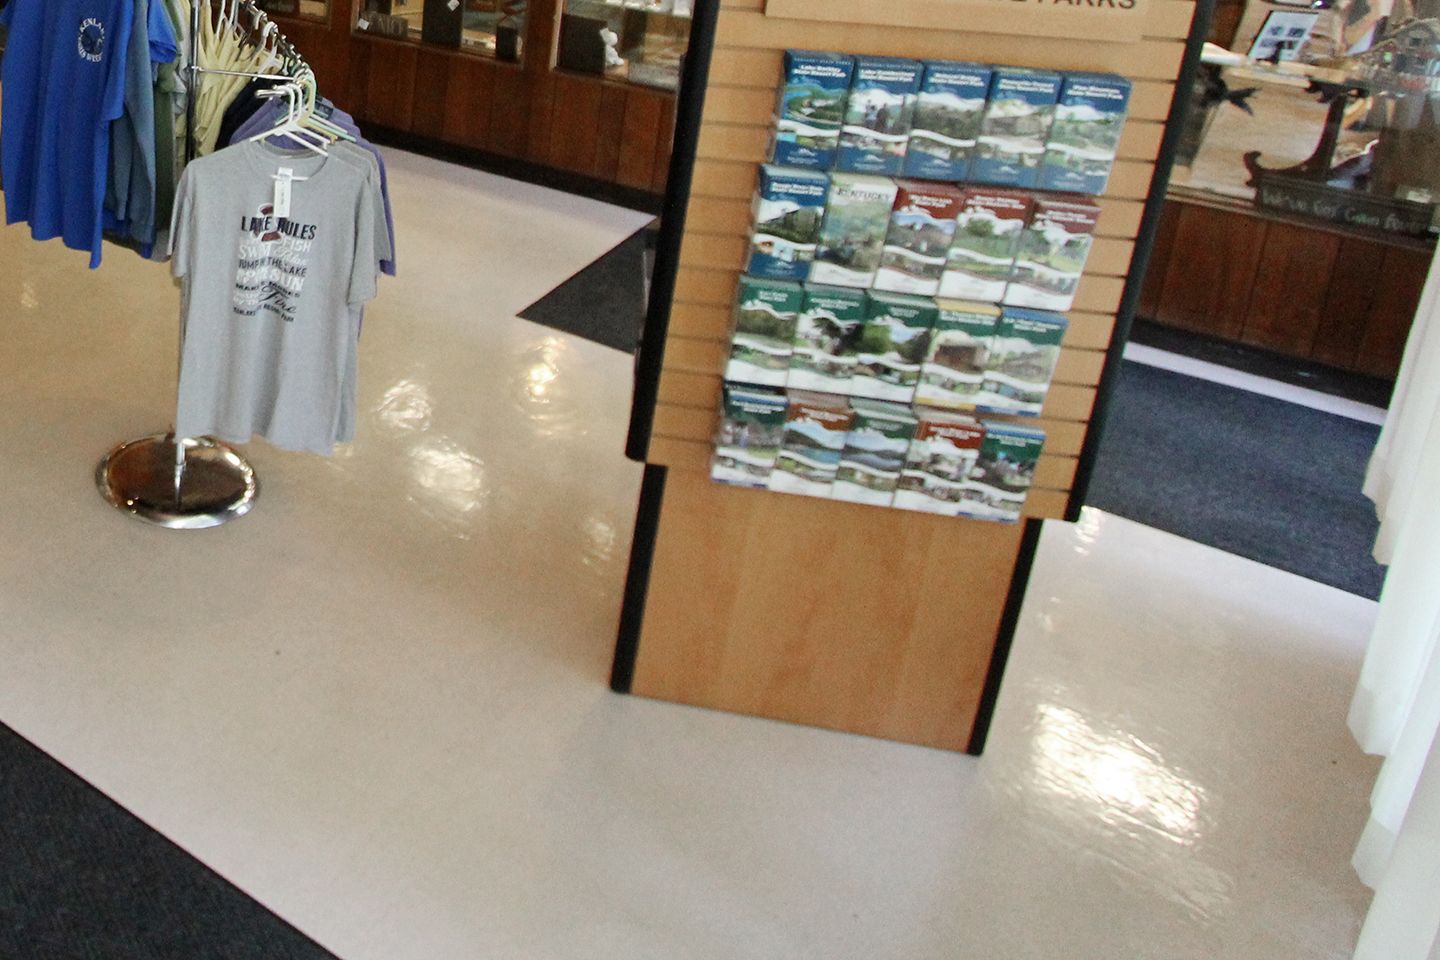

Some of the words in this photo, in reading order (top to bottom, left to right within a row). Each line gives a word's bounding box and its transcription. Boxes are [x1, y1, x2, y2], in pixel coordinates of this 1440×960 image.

[837, 187, 891, 201] KENTUCKY
[241, 216, 272, 231] LAKE
[277, 217, 317, 240] RULES
